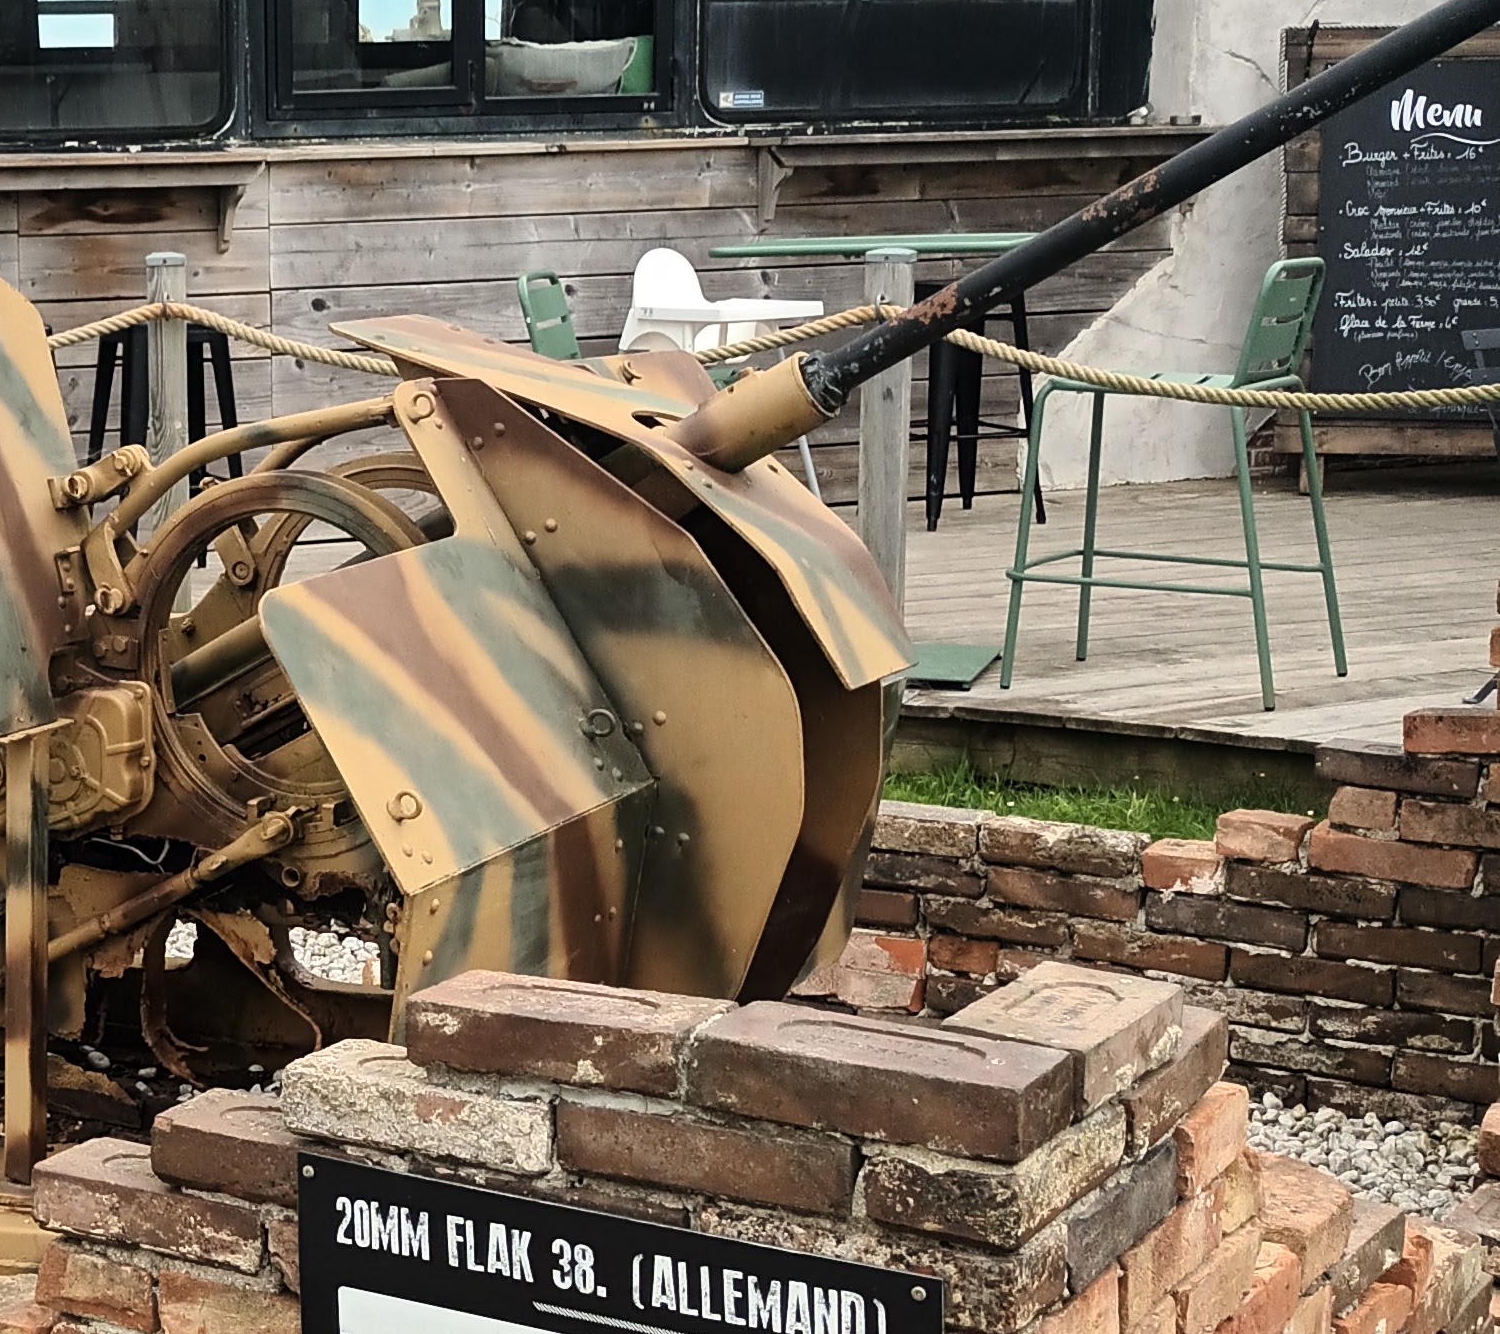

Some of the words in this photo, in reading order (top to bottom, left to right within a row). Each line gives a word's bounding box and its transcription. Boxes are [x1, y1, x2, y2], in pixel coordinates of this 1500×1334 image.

[1391, 89, 1482, 131] Menu
[1342, 142, 1398, 167] Burger
[1346, 200, 1370, 216] Croc
[1343, 241, 1395, 259] Salades
[1339, 314, 1370, 338] Glace
[1375, 315, 1388, 329] de
[336, 1197, 430, 1260] 20MM
[446, 1215, 534, 1283] FLAK
[552, 1238, 607, 1298] 38.
